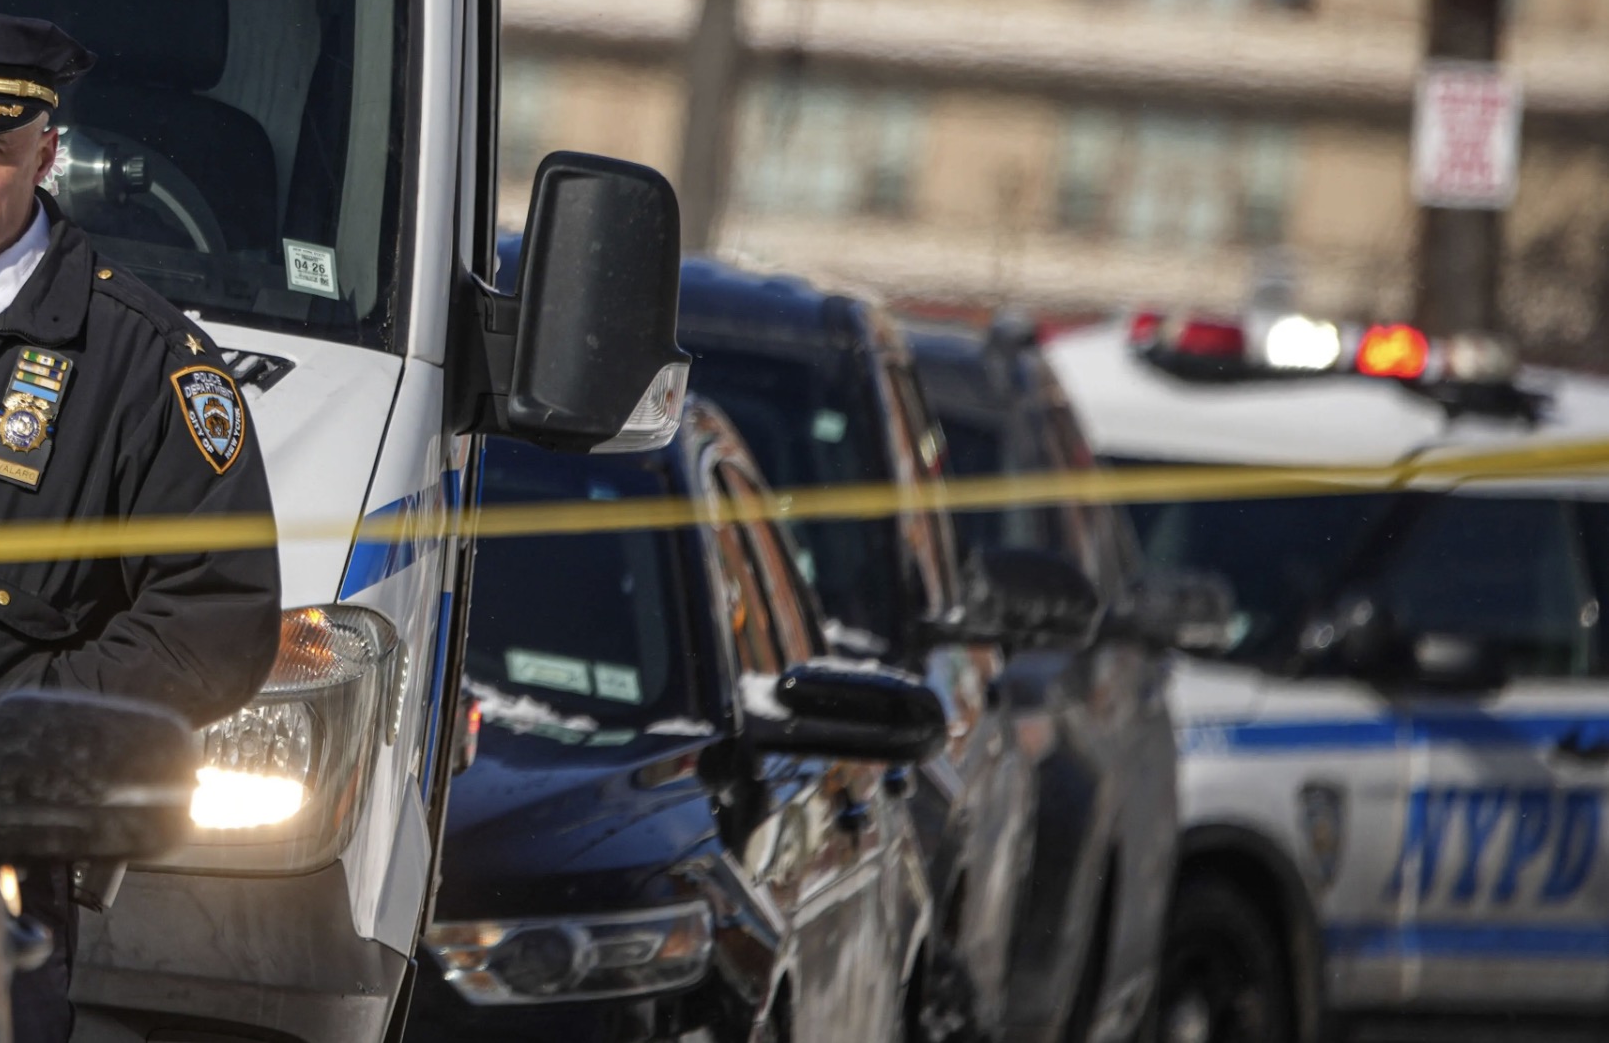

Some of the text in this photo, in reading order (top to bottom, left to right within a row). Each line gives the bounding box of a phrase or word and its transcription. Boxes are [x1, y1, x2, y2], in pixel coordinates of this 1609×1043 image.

[184, 383, 235, 400] DEPARTMENT
[193, 372, 223, 386] POLICE
[189, 410, 215, 454] CITY OF
[224, 407, 242, 459] NEW YORK
[1387, 786, 1603, 904] NYPD
